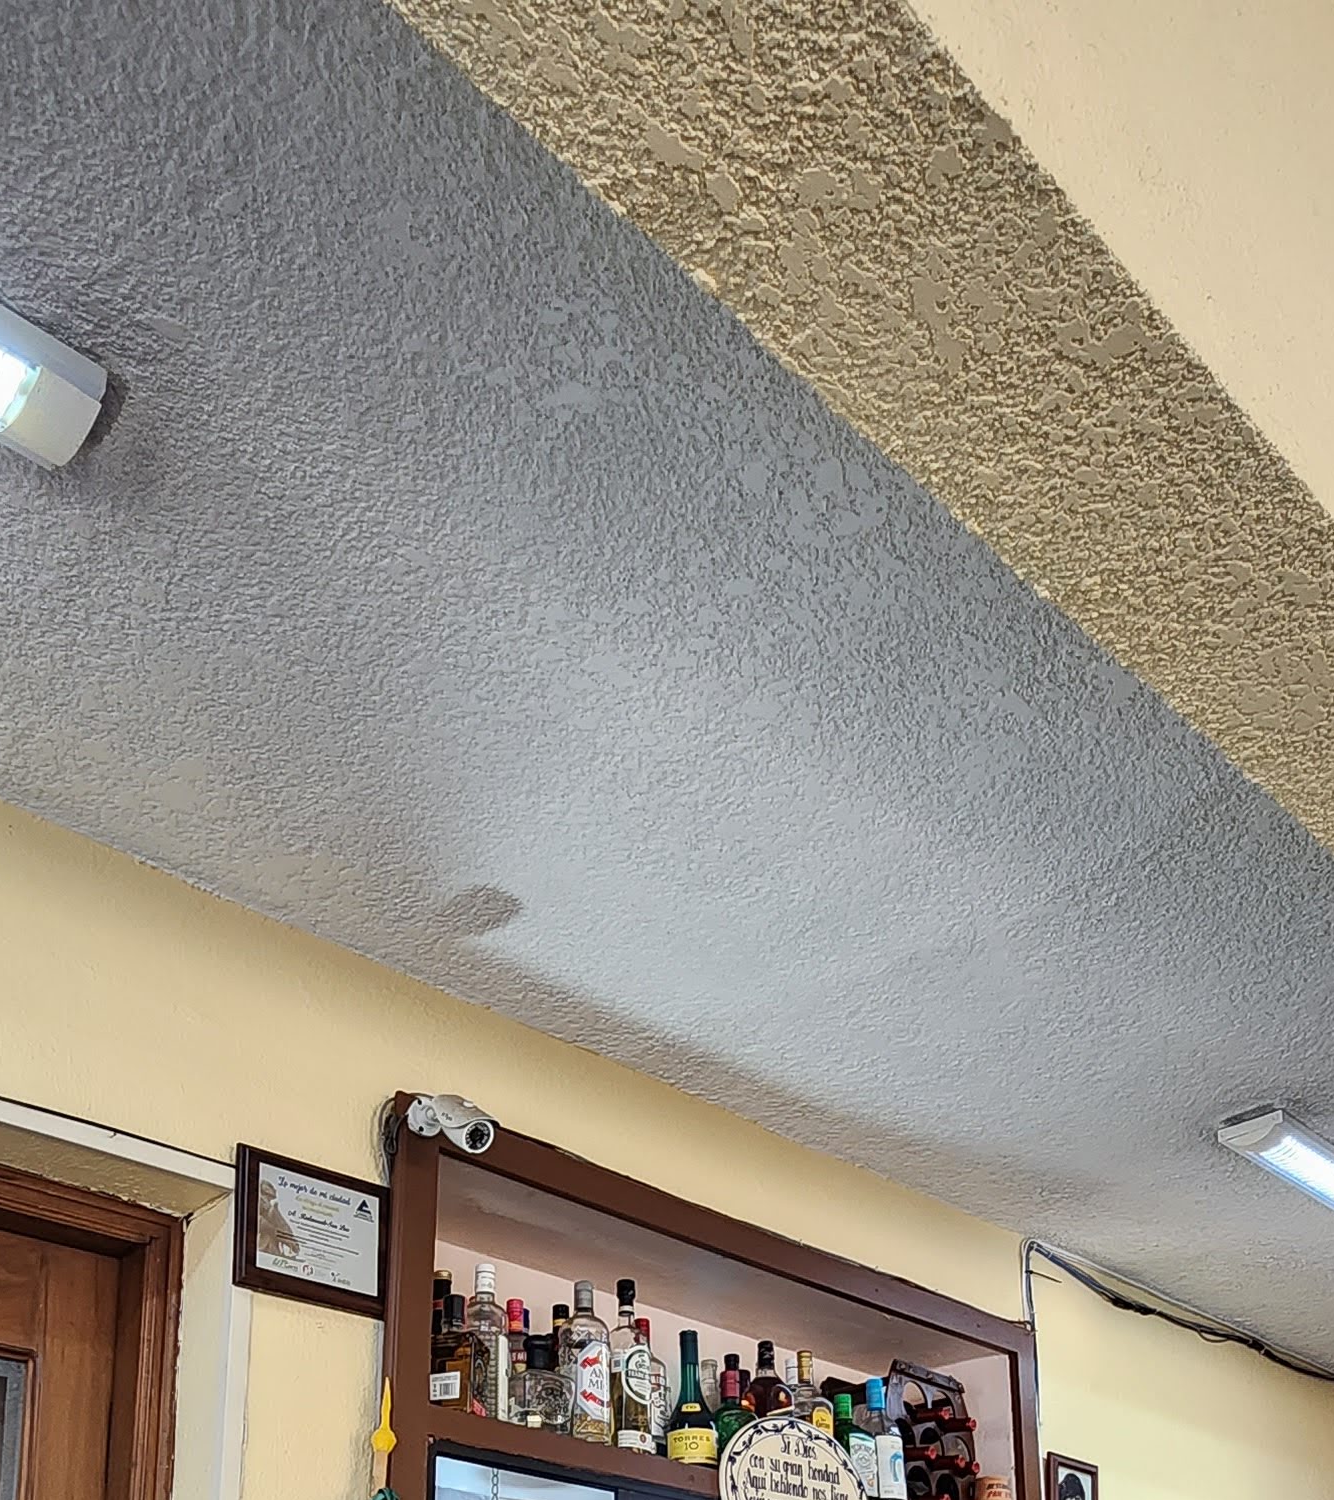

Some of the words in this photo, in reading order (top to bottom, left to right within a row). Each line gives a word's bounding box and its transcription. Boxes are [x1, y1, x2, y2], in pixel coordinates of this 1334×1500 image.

[673, 1435, 711, 1443] TORRES
[684, 1441, 699, 1451] 10
[780, 1433, 791, 1454] Si
[795, 1437, 817, 1459] Dios
[749, 1453, 765, 1470] con
[769, 1457, 781, 1473] su
[783, 1460, 803, 1480] gran
[808, 1460, 840, 1485] bondad
[770, 1471, 809, 1499] bebiendo
